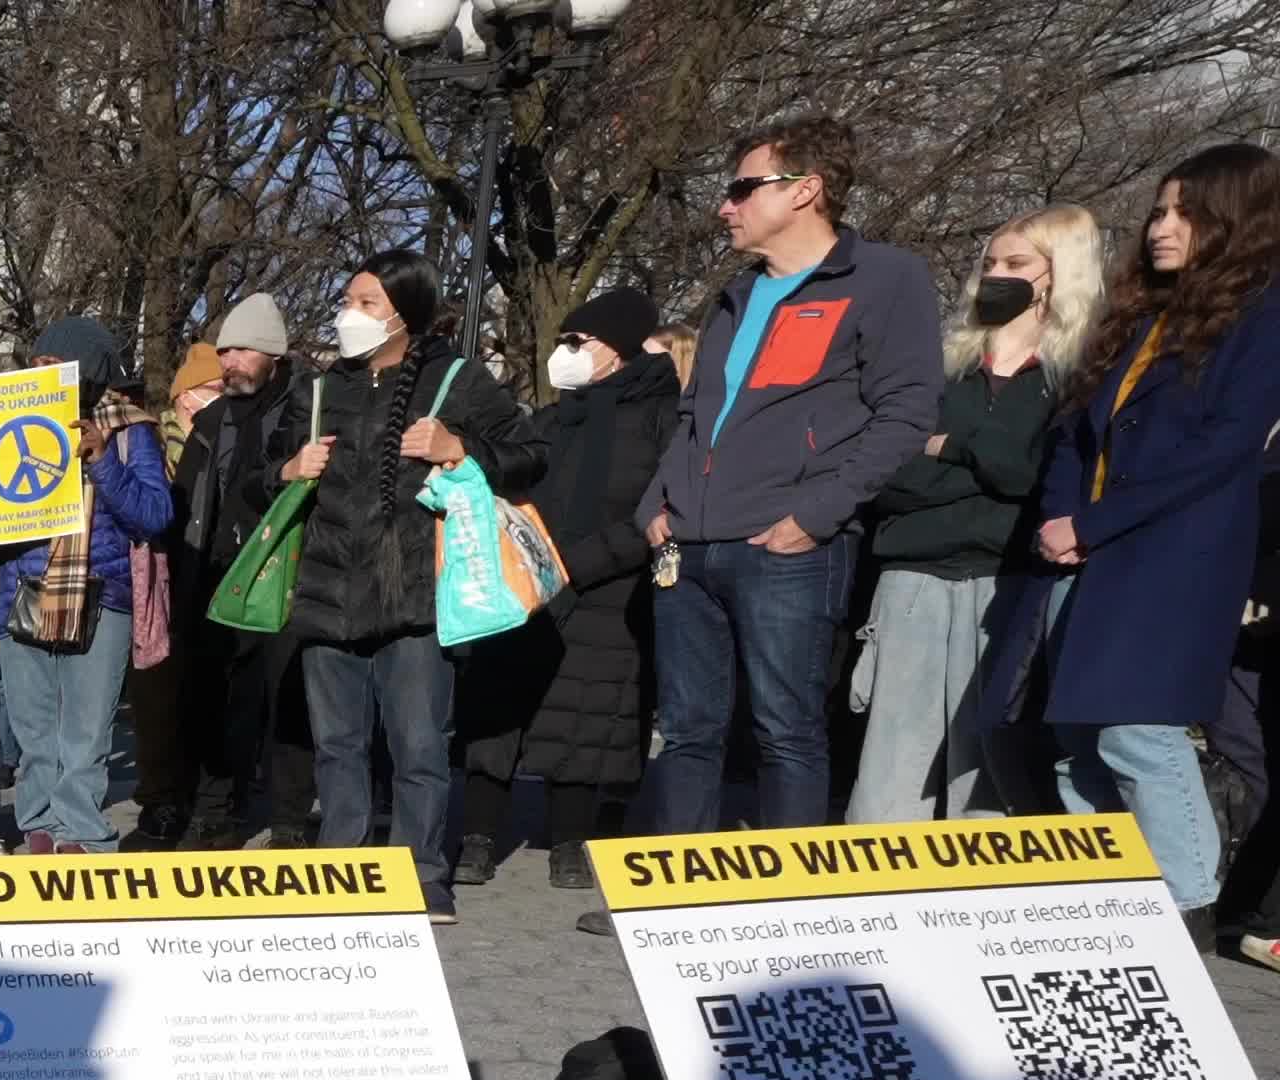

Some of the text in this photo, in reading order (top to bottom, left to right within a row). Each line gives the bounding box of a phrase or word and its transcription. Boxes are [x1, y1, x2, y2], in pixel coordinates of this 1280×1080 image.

[9, 390, 68, 411] UKRAINE
[624, 826, 1121, 885] STAND WITH UKRAINE
[30, 867, 157, 900] WITH
[173, 862, 385, 897] UKRAINE
[916, 897, 1164, 930] Write your elected officials
[145, 930, 420, 958] Write your elected officials
[632, 911, 898, 948] Share on social media and
[976, 931, 1134, 957] via democracy.io
[10, 939, 75, 958] media
[81, 937, 120, 956] and
[201, 962, 376, 984] via democracy.io
[674, 948, 888, 982] tag your government
